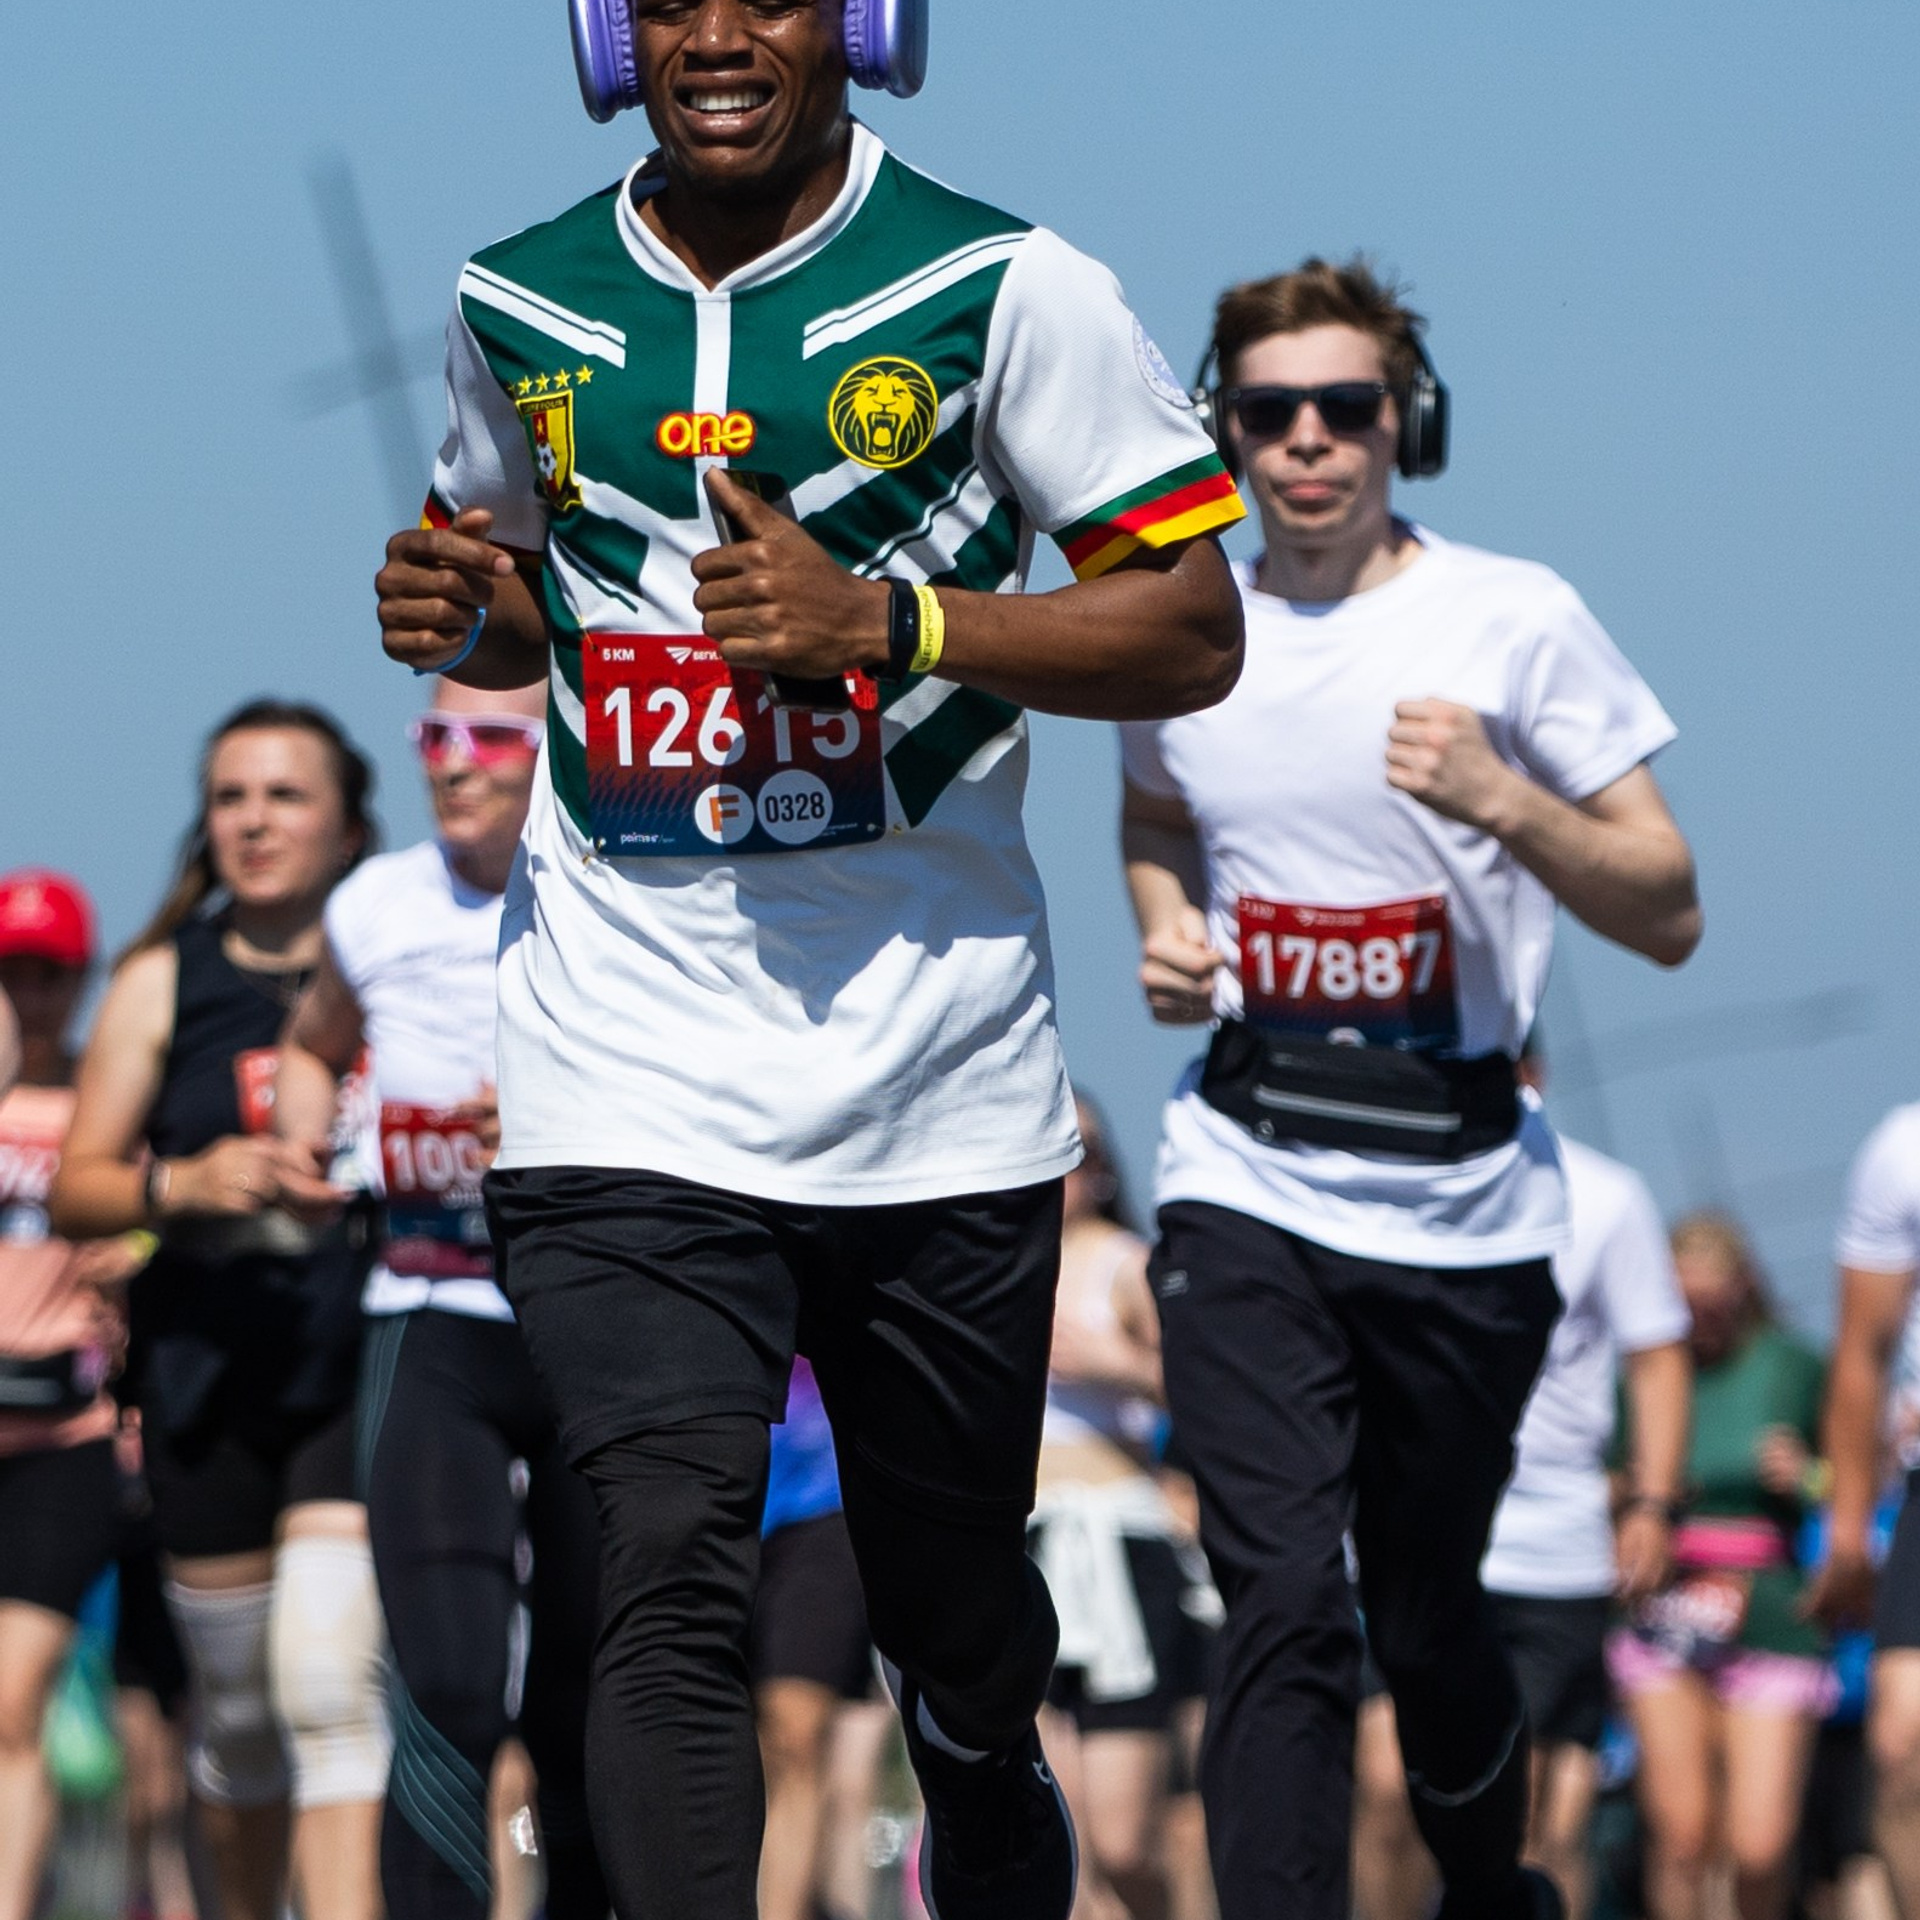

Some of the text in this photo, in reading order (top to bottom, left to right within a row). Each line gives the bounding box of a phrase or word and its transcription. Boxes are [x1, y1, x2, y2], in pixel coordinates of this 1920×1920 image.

[659, 413, 755, 455] one
[604, 680, 861, 767] 12615
[708, 794, 740, 833] F
[764, 791, 826, 824] 0328
[1247, 928, 1442, 1001] 17887
